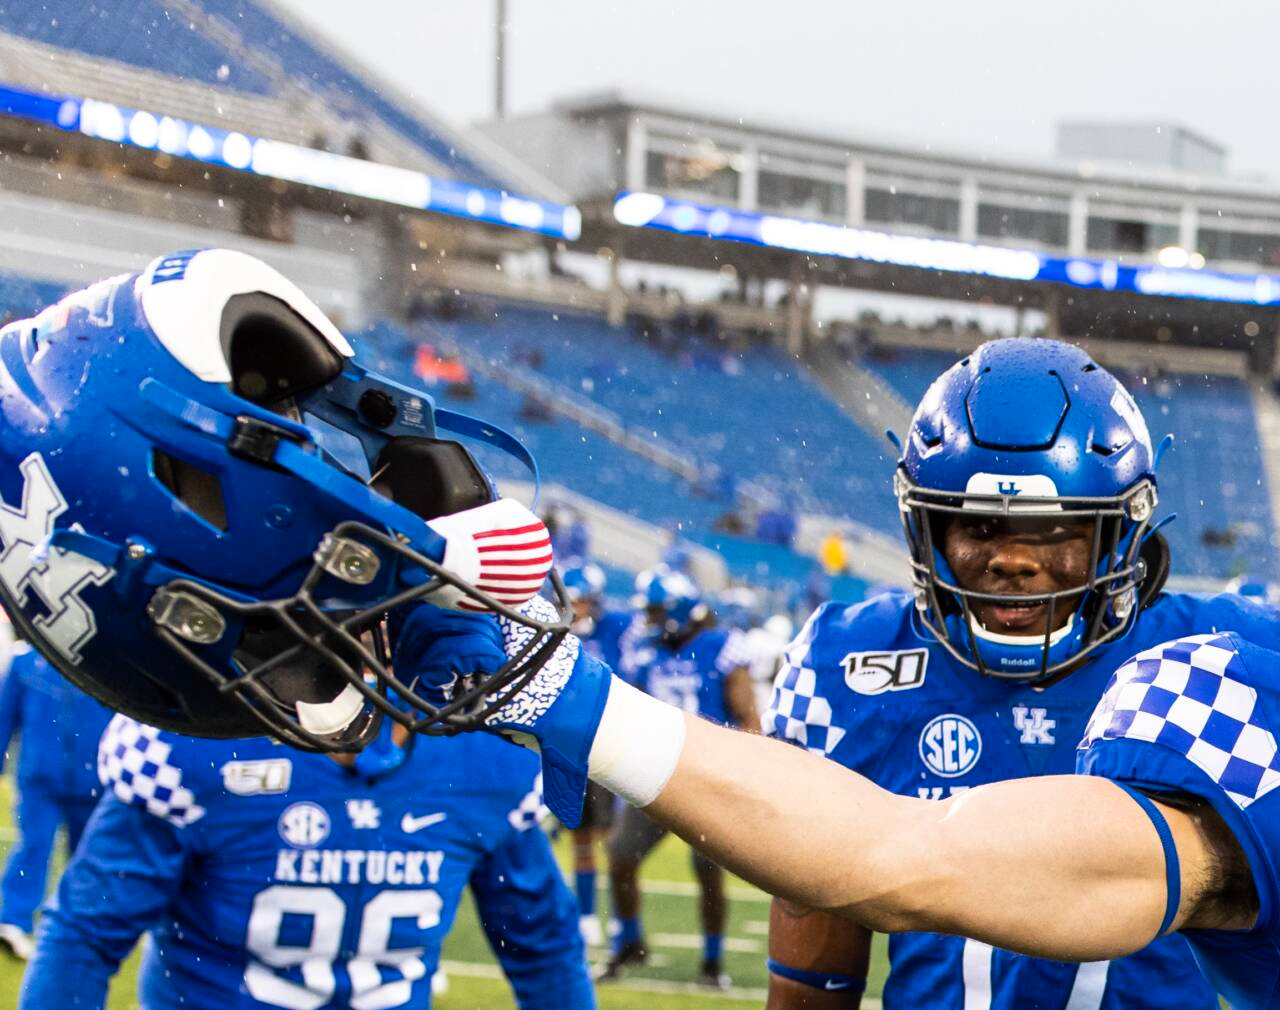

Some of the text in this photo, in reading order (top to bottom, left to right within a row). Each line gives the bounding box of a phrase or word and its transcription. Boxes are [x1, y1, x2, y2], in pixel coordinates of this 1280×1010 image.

[846, 650, 926, 691] 150
[1012, 707, 1056, 745] UK
[924, 719, 976, 774] SEC
[275, 849, 444, 885] KENTUCKY
